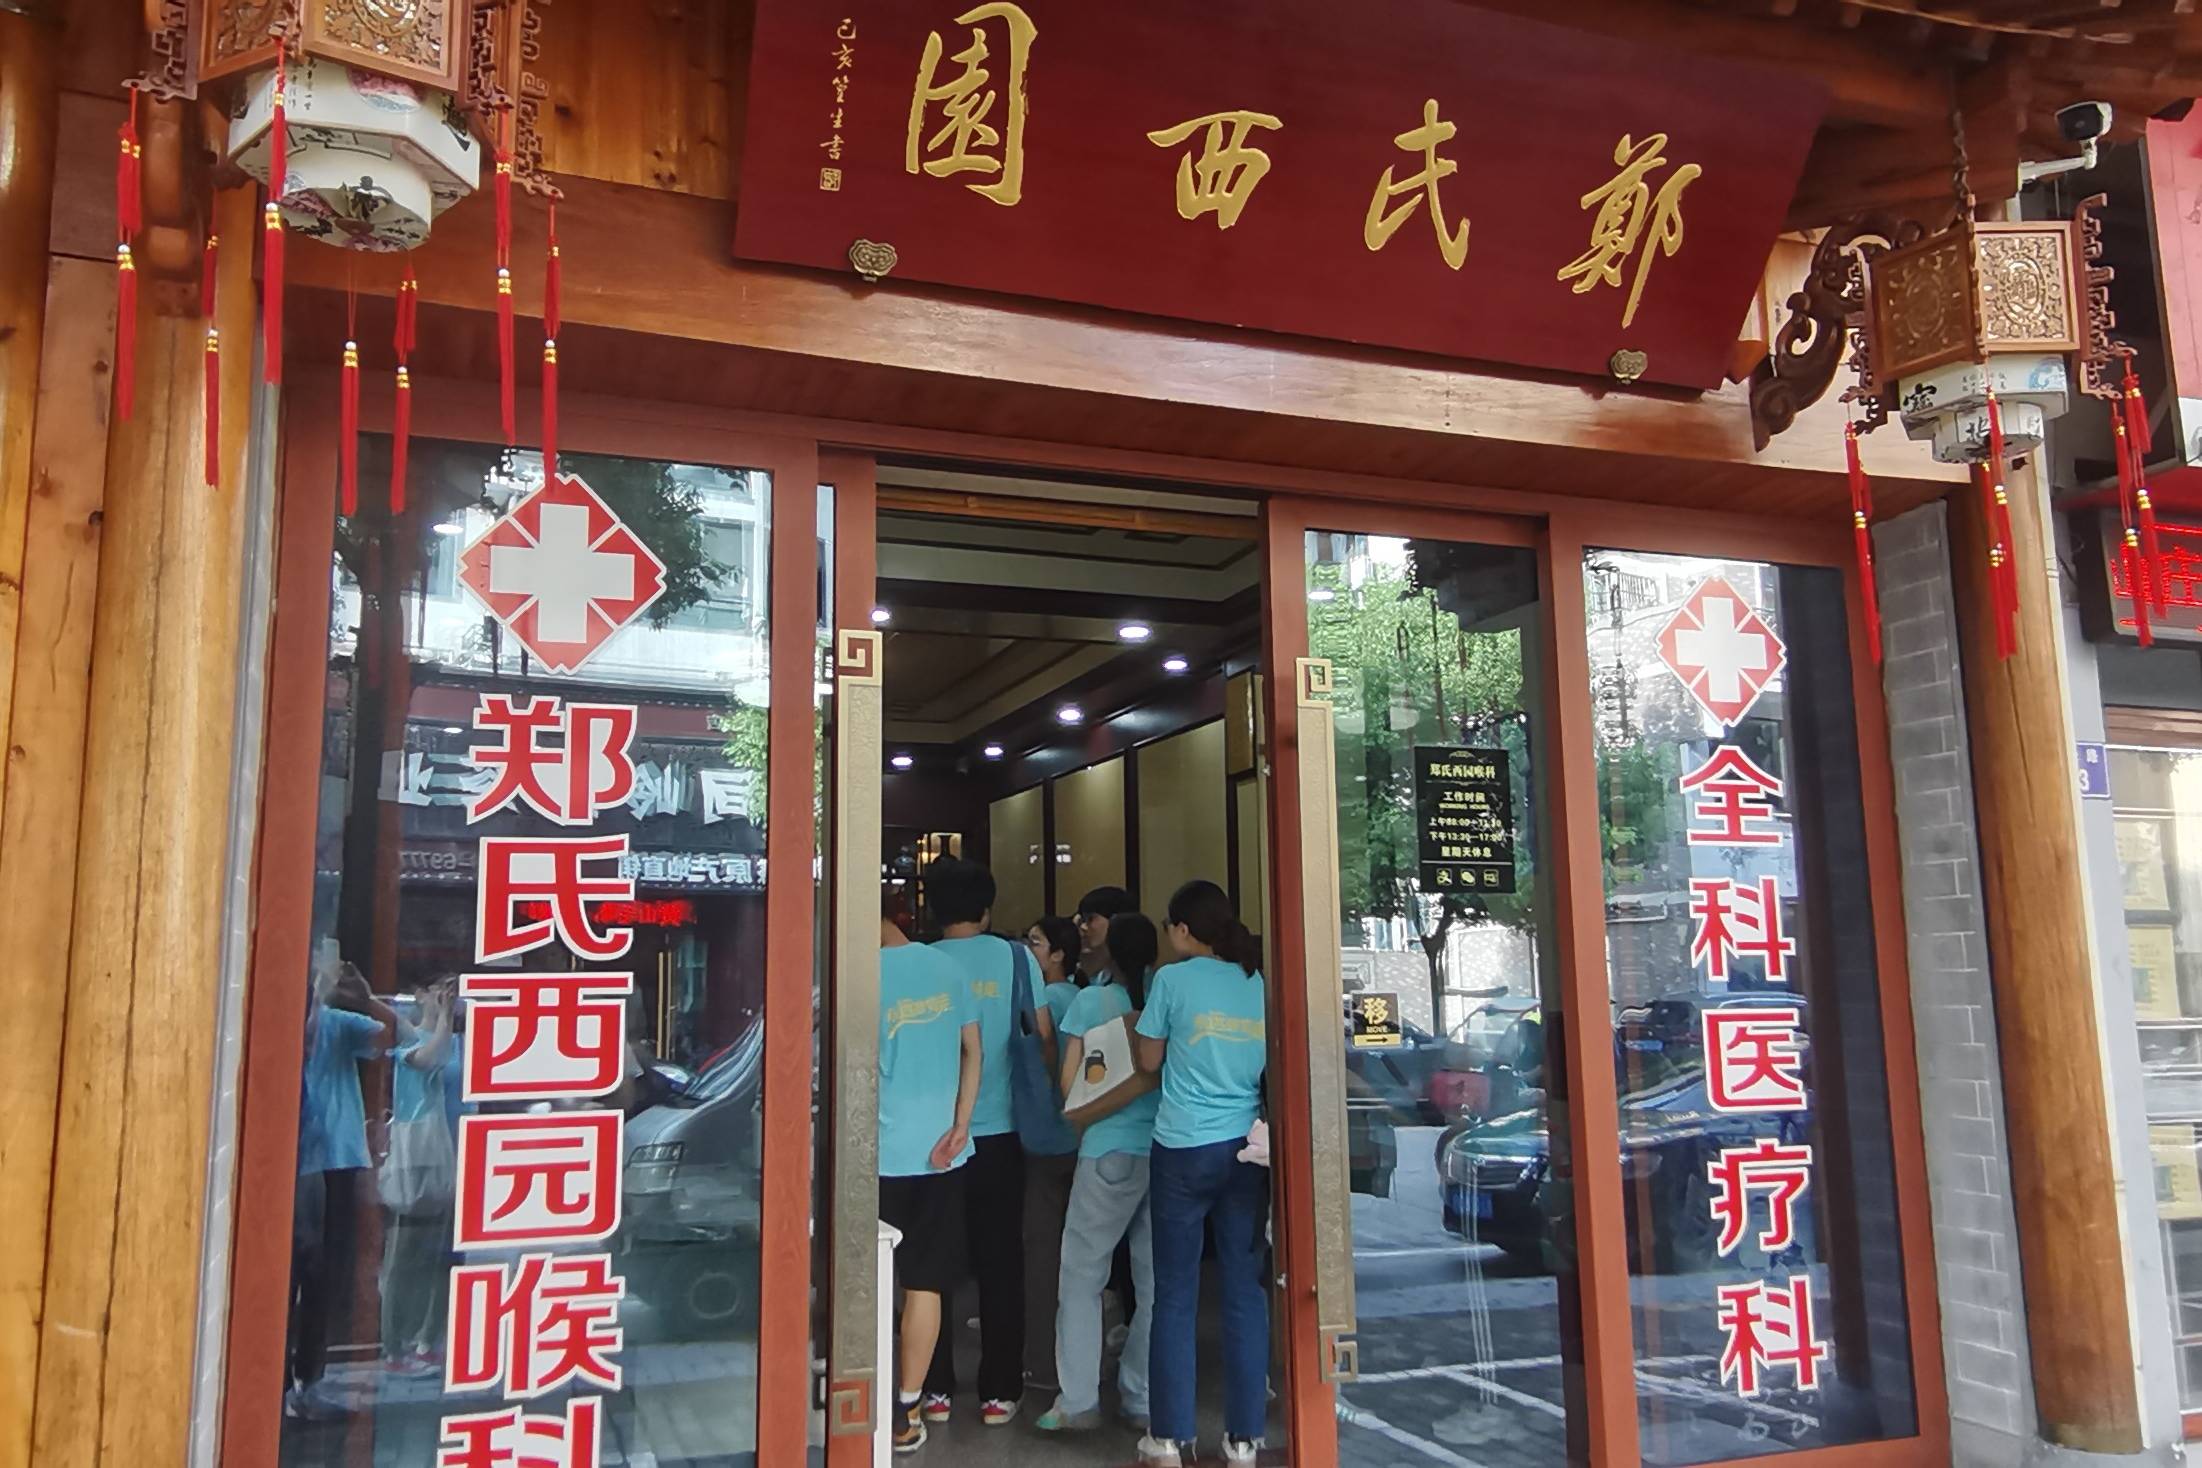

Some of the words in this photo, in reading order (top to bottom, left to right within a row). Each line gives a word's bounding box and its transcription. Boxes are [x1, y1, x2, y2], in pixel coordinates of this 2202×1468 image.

[1430, 763, 1496, 779] 郑氏西园喉科
[1442, 791, 1486, 803] 工作时间
[1441, 846, 1492, 858] 星期天休息
[1364, 997, 1388, 1025] 移
[437, 692, 638, 1468] 郑氏西园喉科
[1680, 744, 1828, 1397] 全科医疗科
